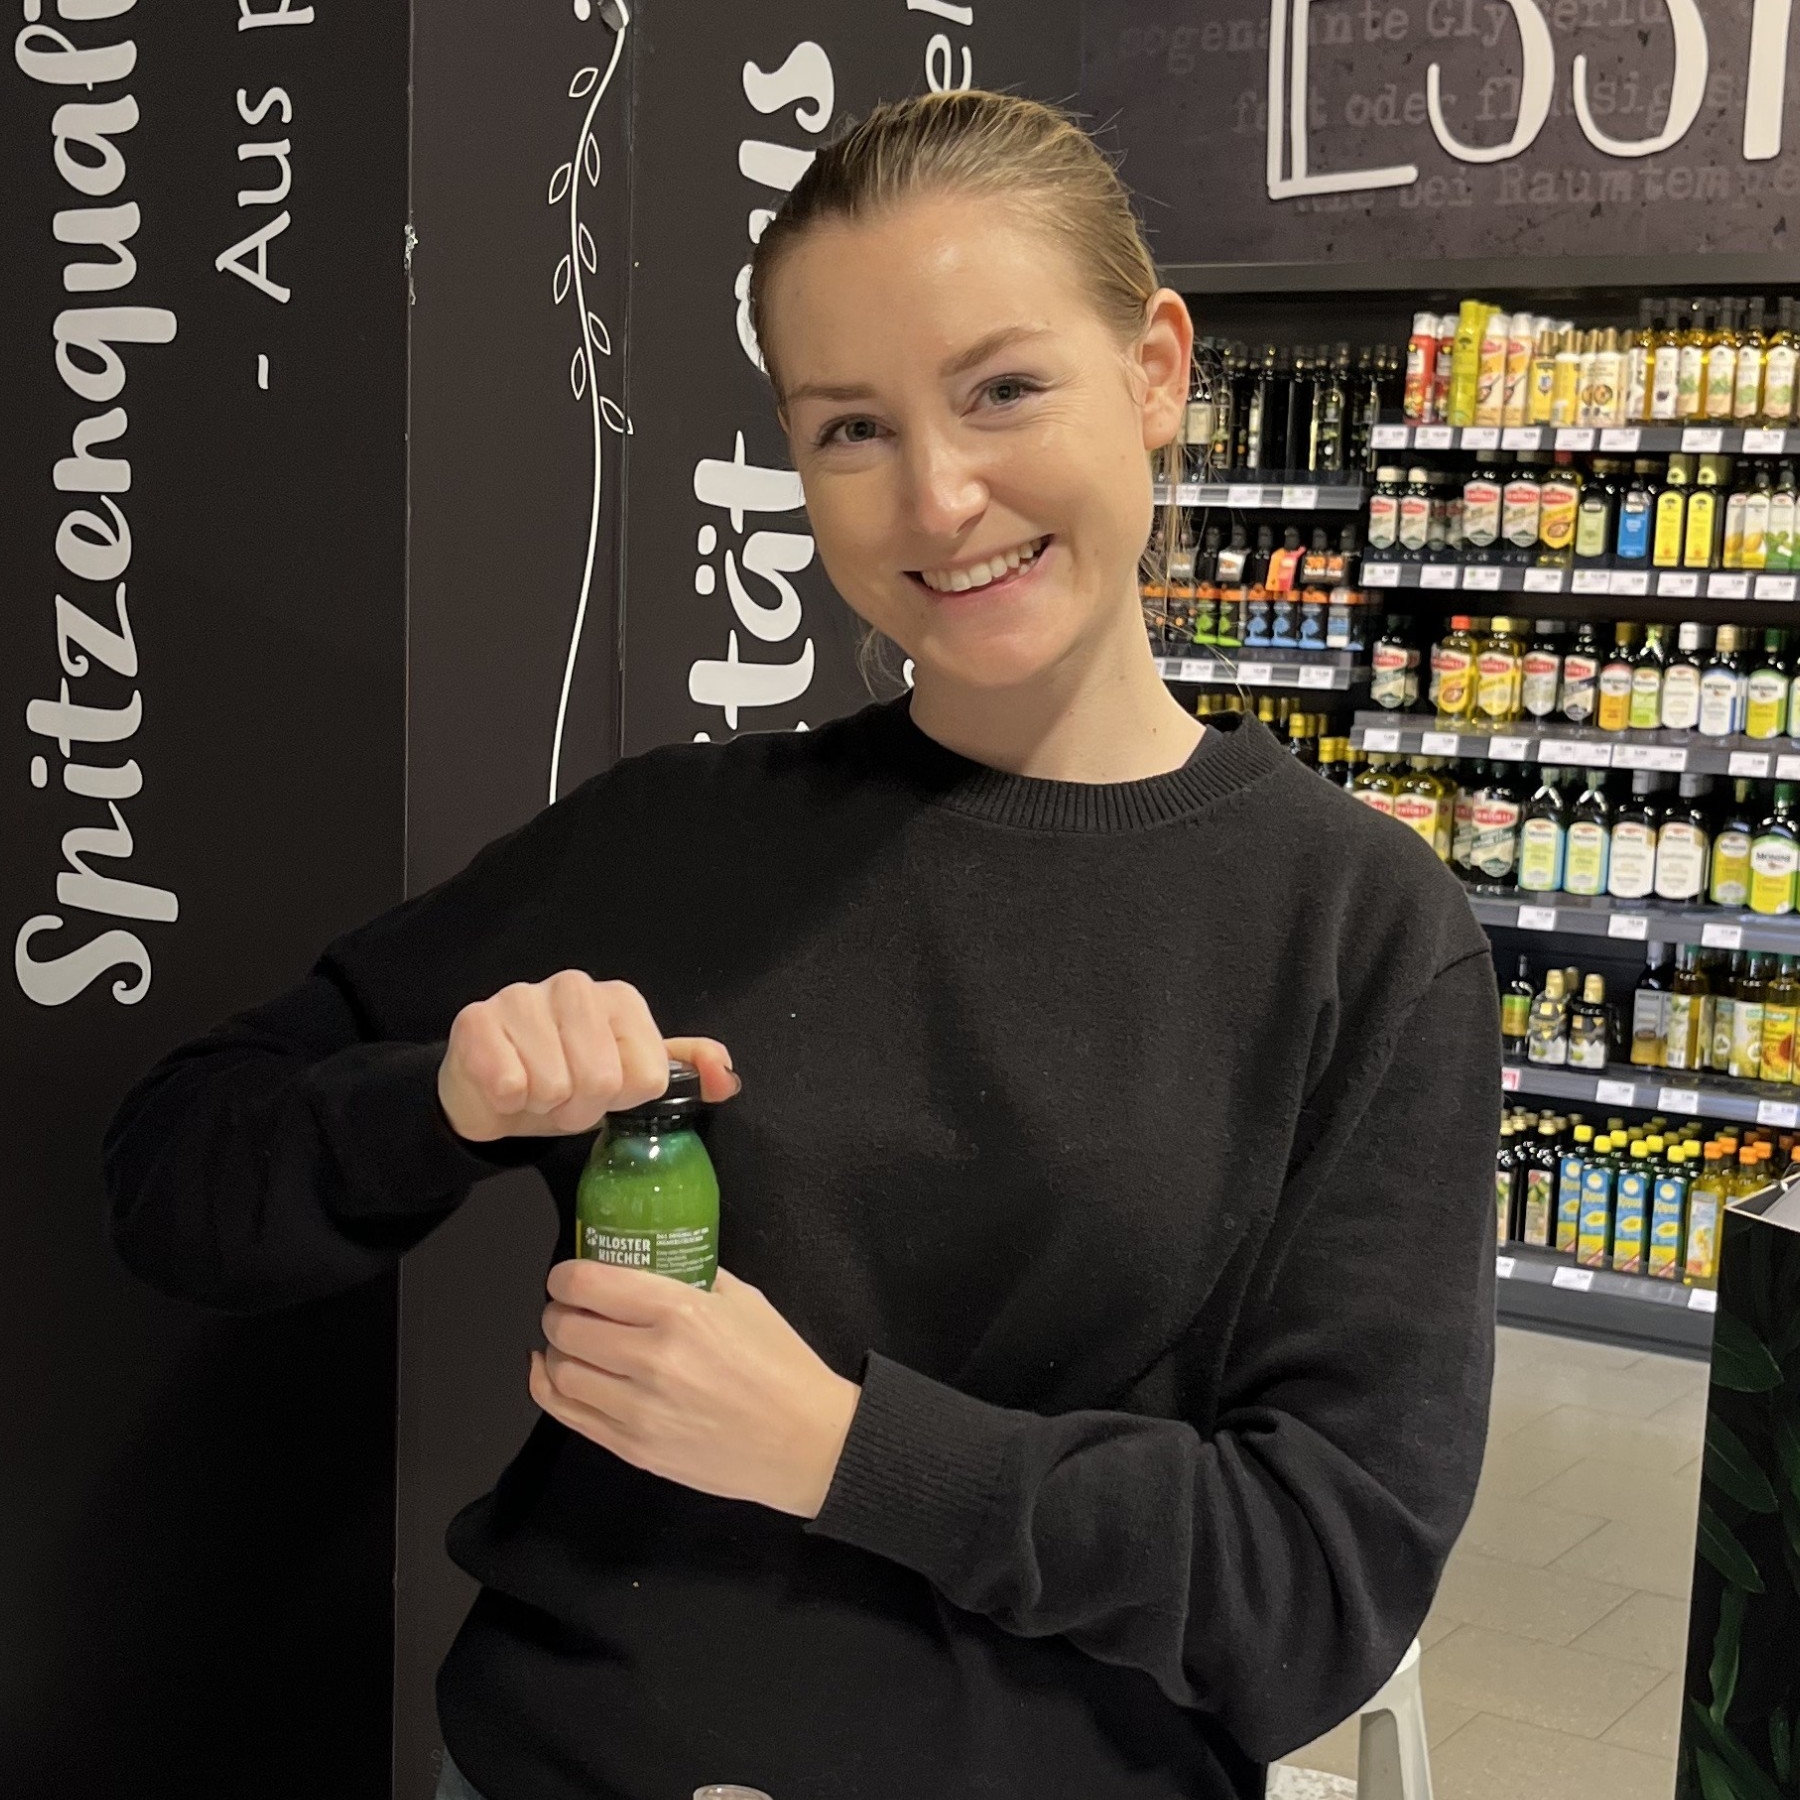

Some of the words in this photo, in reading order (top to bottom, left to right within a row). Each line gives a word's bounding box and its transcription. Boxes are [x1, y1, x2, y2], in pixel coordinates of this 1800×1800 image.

[214, 86, 293, 304] Aus
[597, 1234, 651, 1252] KLOSTER
[597, 1248, 651, 1266] KITCHEN
